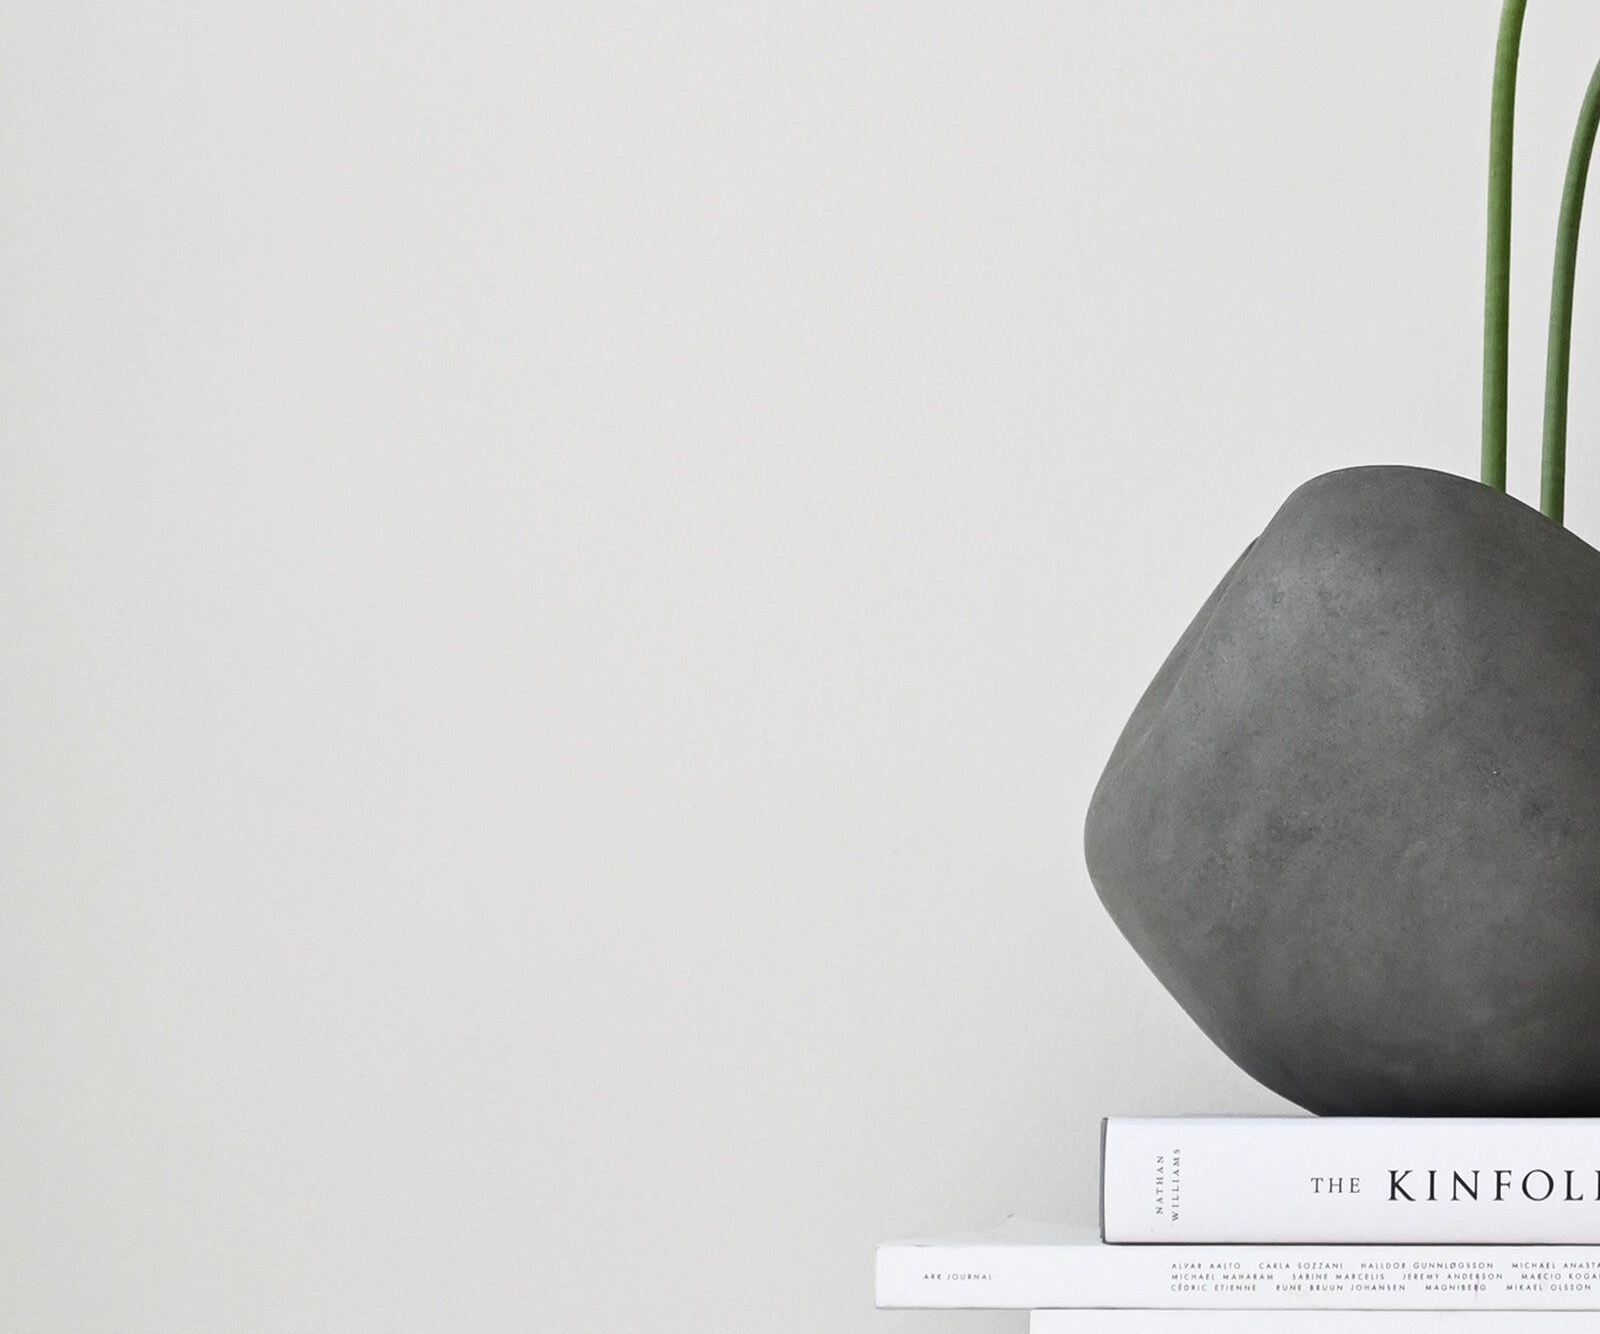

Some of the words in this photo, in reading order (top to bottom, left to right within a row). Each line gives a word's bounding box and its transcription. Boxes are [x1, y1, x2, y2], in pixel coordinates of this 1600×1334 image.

[1155, 1155, 1164, 1215] NATHAN
[1171, 1148, 1181, 1222] WILLIAMS
[1310, 1177, 1361, 1194] THE
[1171, 1262, 1202, 1270] ALVAR
[1209, 1262, 1241, 1270] AALTO
[1258, 1261, 1291, 1270] CARLA
[1297, 1261, 1343, 1270] SOZZANI
[1360, 1261, 1406, 1270] HALLDOR
[1511, 1261, 1556, 1270] MICHAEL
[946, 1273, 992, 1281] JOURNAL
[1171, 1273, 1215, 1281] MICHAEL
[1222, 1273, 1274, 1281] MAHARAM
[1291, 1273, 1328, 1281] SABINE
[1335, 1272, 1385, 1281] MARCELIS
[1402, 1272, 1440, 1281] JEREMY
[1446, 1272, 1503, 1281] ANDERSON
[1520, 1272, 1562, 1281] MARCIO
[1170, 1282, 1207, 1292] CÉDRIC
[1214, 1283, 1257, 1292] ETIENNE
[1275, 1283, 1302, 1292] RUNE
[1309, 1283, 1344, 1292] BRUUN
[1350, 1283, 1406, 1292] JOHANSEN
[1425, 1283, 1487, 1292] MAGNIBERG
[1505, 1283, 1543, 1292] MIKAEL
[1550, 1283, 1592, 1292] OLSSON
